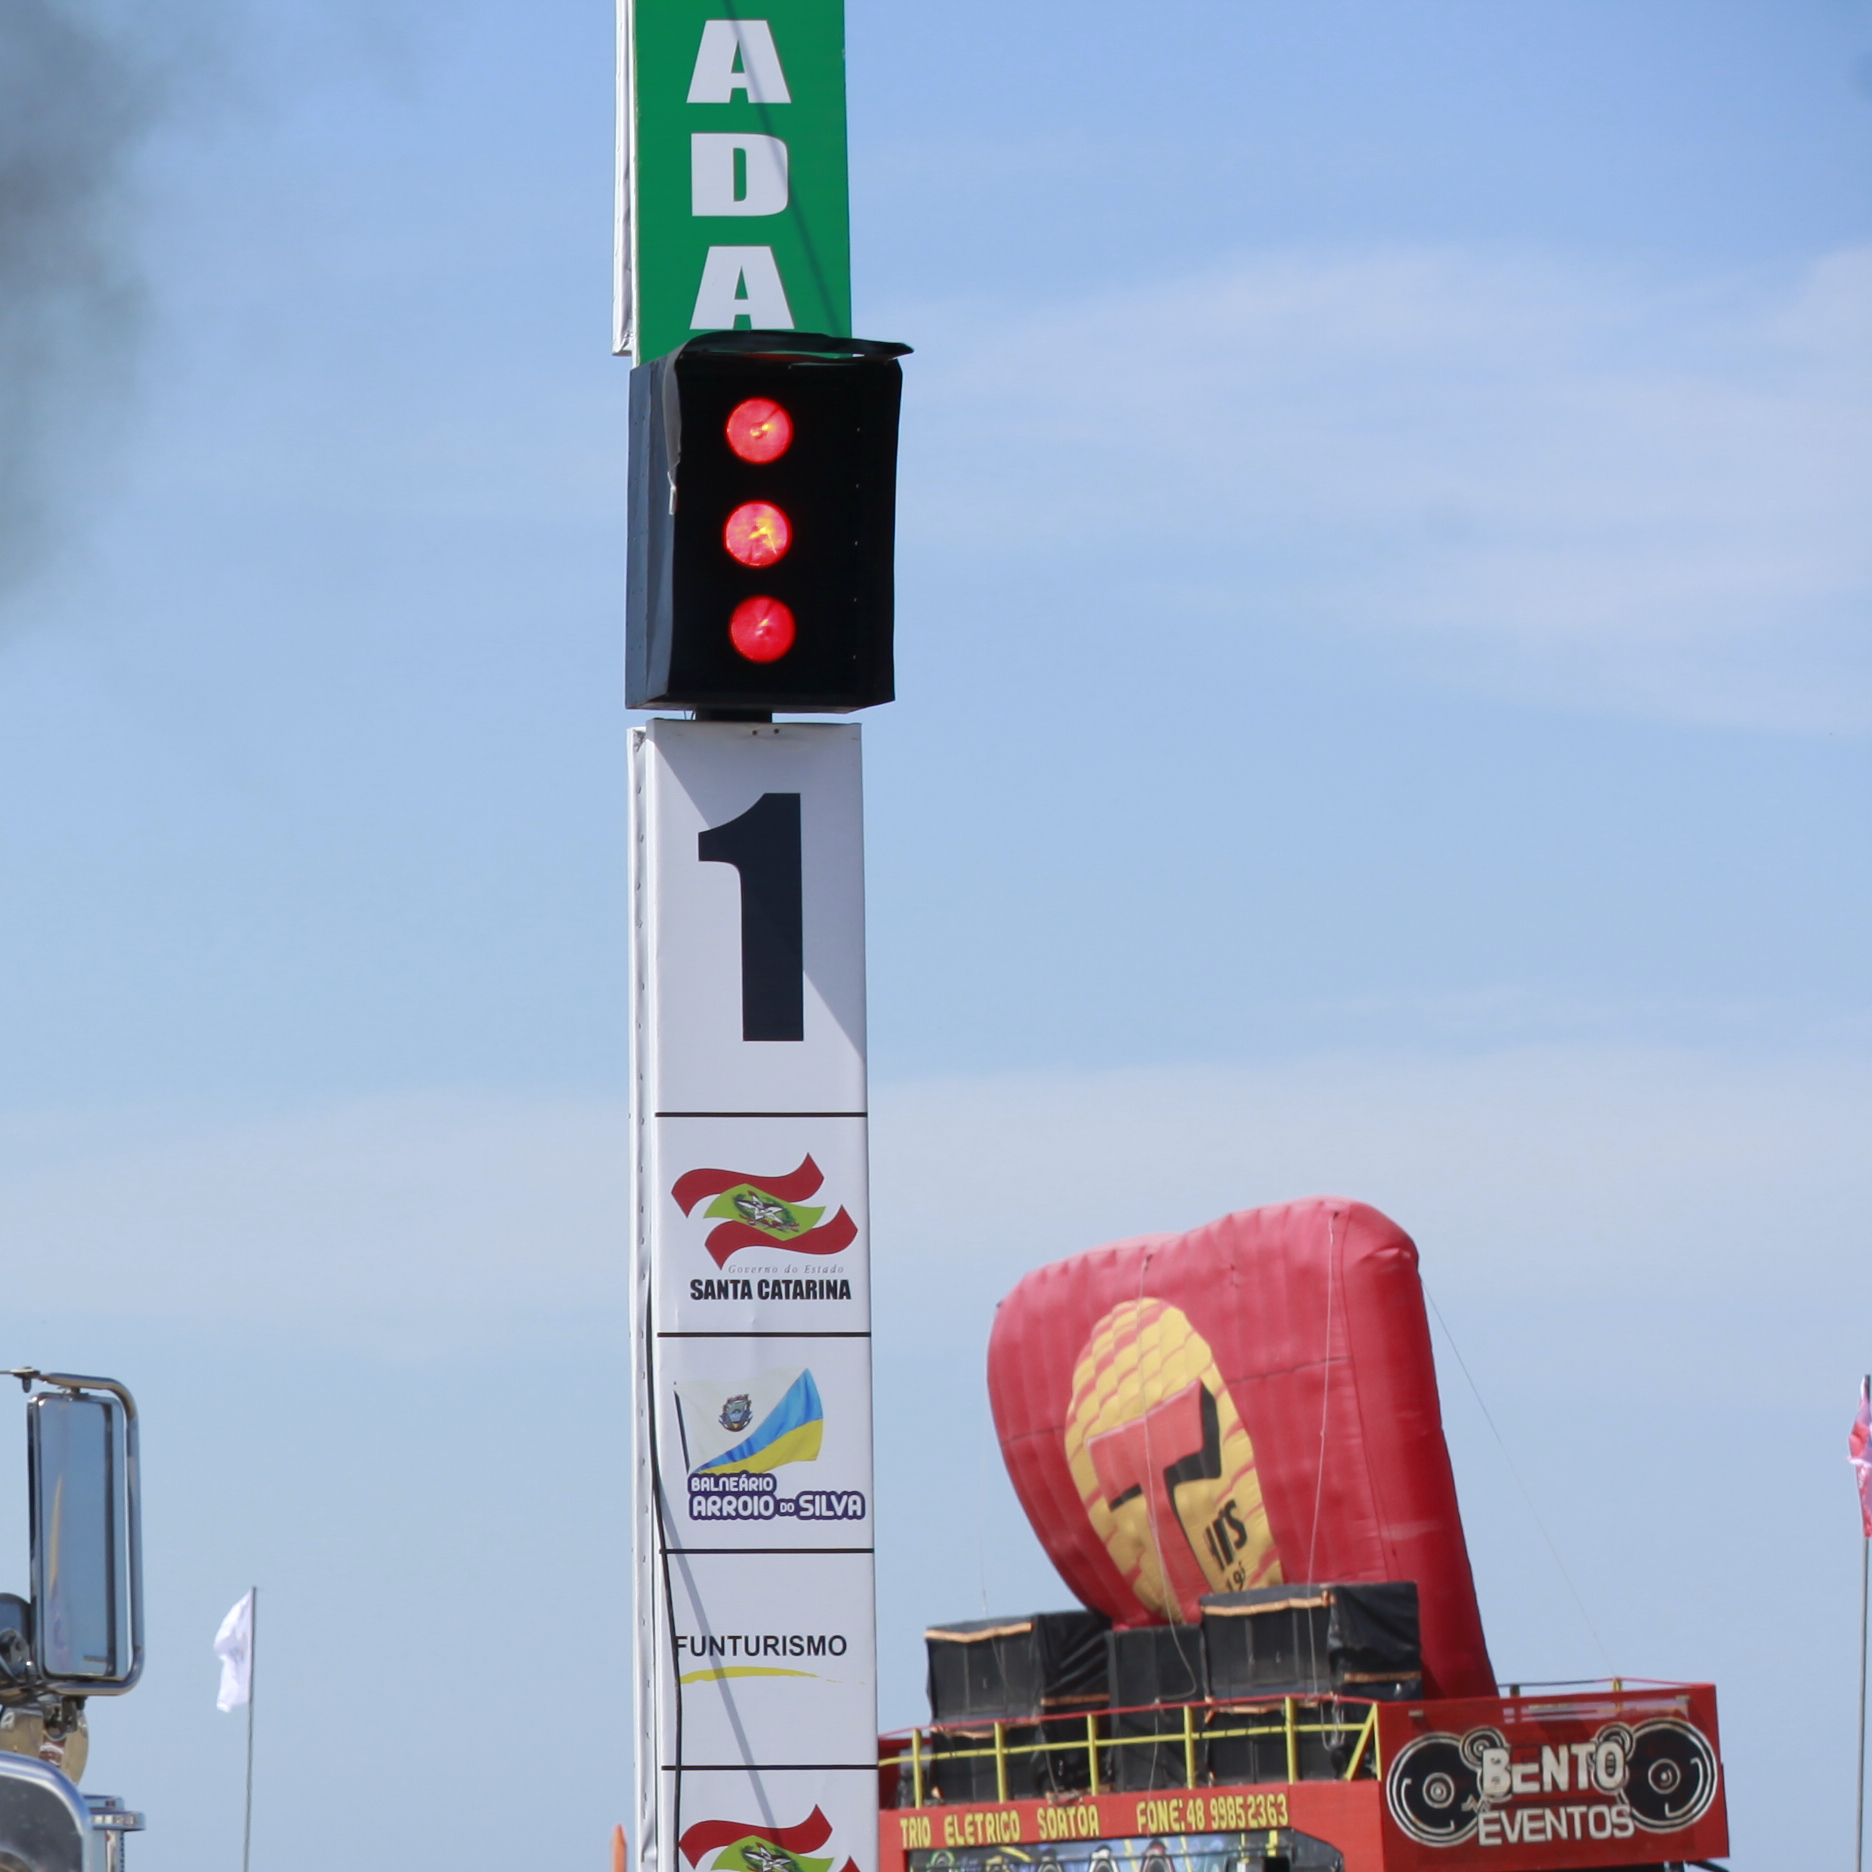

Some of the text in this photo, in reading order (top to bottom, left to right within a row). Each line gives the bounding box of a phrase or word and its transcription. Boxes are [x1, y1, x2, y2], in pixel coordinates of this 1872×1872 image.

[698, 793, 804, 1042] 1
[728, 1264, 844, 1274] Governo do Estado
[690, 1279, 852, 1300] SANTA CATARINA
[690, 1474, 774, 1492] BALNEÁRIO
[692, 1494, 862, 1517] ARROIO DO SILVA
[675, 1634, 847, 1657] FUNTURISMO
[1480, 1741, 1626, 1798] BENTO
[900, 1816, 931, 1849] TRIO
[944, 1809, 1021, 1846] ELETRICO
[1186, 1797, 1206, 1831] 48
[1477, 1805, 1635, 1846] EVENTOS
